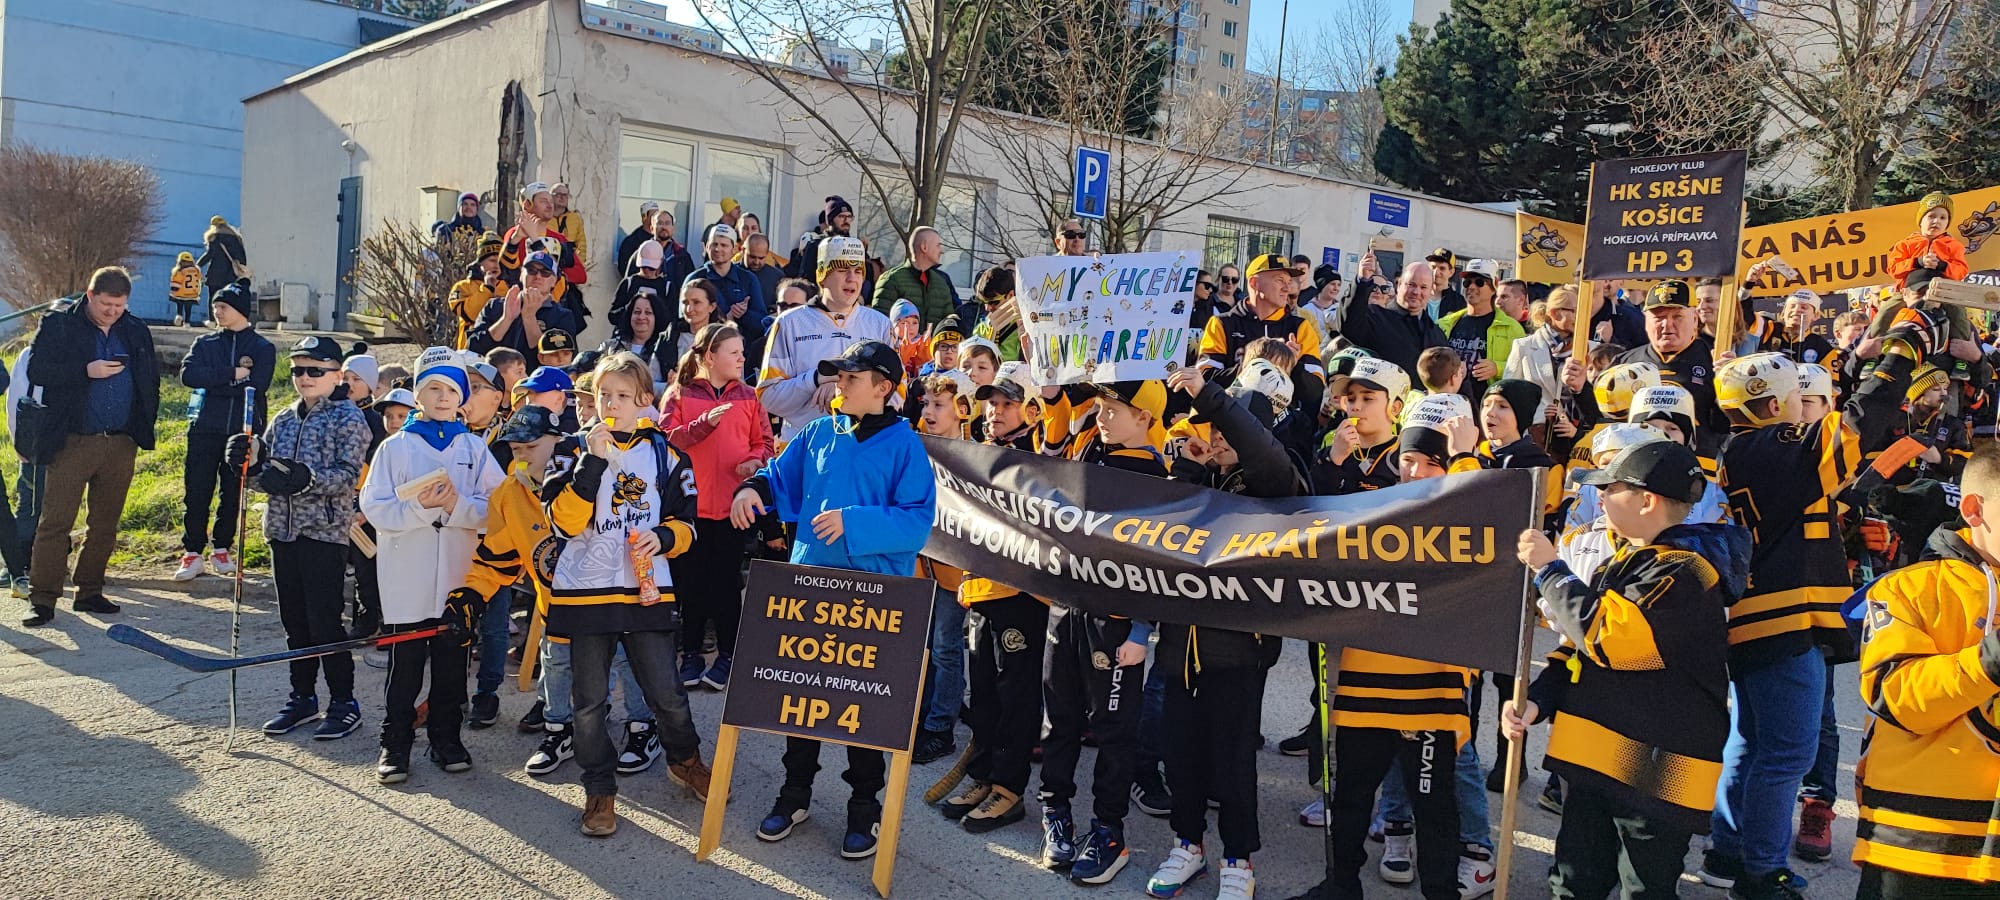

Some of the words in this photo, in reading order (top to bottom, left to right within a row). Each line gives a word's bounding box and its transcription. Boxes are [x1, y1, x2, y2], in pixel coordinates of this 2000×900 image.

[1085, 157, 1101, 193] P
[1630, 162, 1679, 173] HOKEJOVÝ
[1681, 161, 1705, 170] KLUB
[1609, 183, 1642, 201] HK
[1648, 175, 1723, 199] SRŠNE
[1621, 203, 1704, 227] KOŠICE
[1603, 232, 1660, 245] HOKEJOVÁ
[1662, 231, 1718, 242] PRÍPRAVKA
[1791, 219, 1866, 253] NÁS
[1627, 251, 1668, 273] HP
[1674, 249, 1694, 272] 3
[1038, 267, 1088, 305] MY
[1034, 322, 1088, 370] NOVÚ
[1096, 320, 1183, 364] ARÉNU
[960, 478, 1113, 536] HOKEJISTOV
[1113, 518, 1210, 555] CHCE
[1220, 518, 1329, 559] HRAŤ
[1336, 524, 1496, 564] HOKEJ
[794, 575, 853, 592] HOKEJOVÝ
[855, 582, 884, 594] KLUB
[970, 521, 1041, 570] DOMA
[1048, 546, 1061, 576] S
[1069, 554, 1250, 601] MOBILOM
[1253, 577, 1285, 603] V
[1298, 579, 1418, 616] RUKE
[766, 595, 808, 622] HK
[813, 598, 903, 634] SRŠNE
[778, 632, 878, 669] KOŠICE
[753, 666, 822, 687] HOKEJOVÁ
[825, 675, 892, 697] PRÍPRAVKA
[779, 694, 830, 728] HP
[837, 703, 861, 734] 4
[1419, 729, 1436, 794] GIVOV
